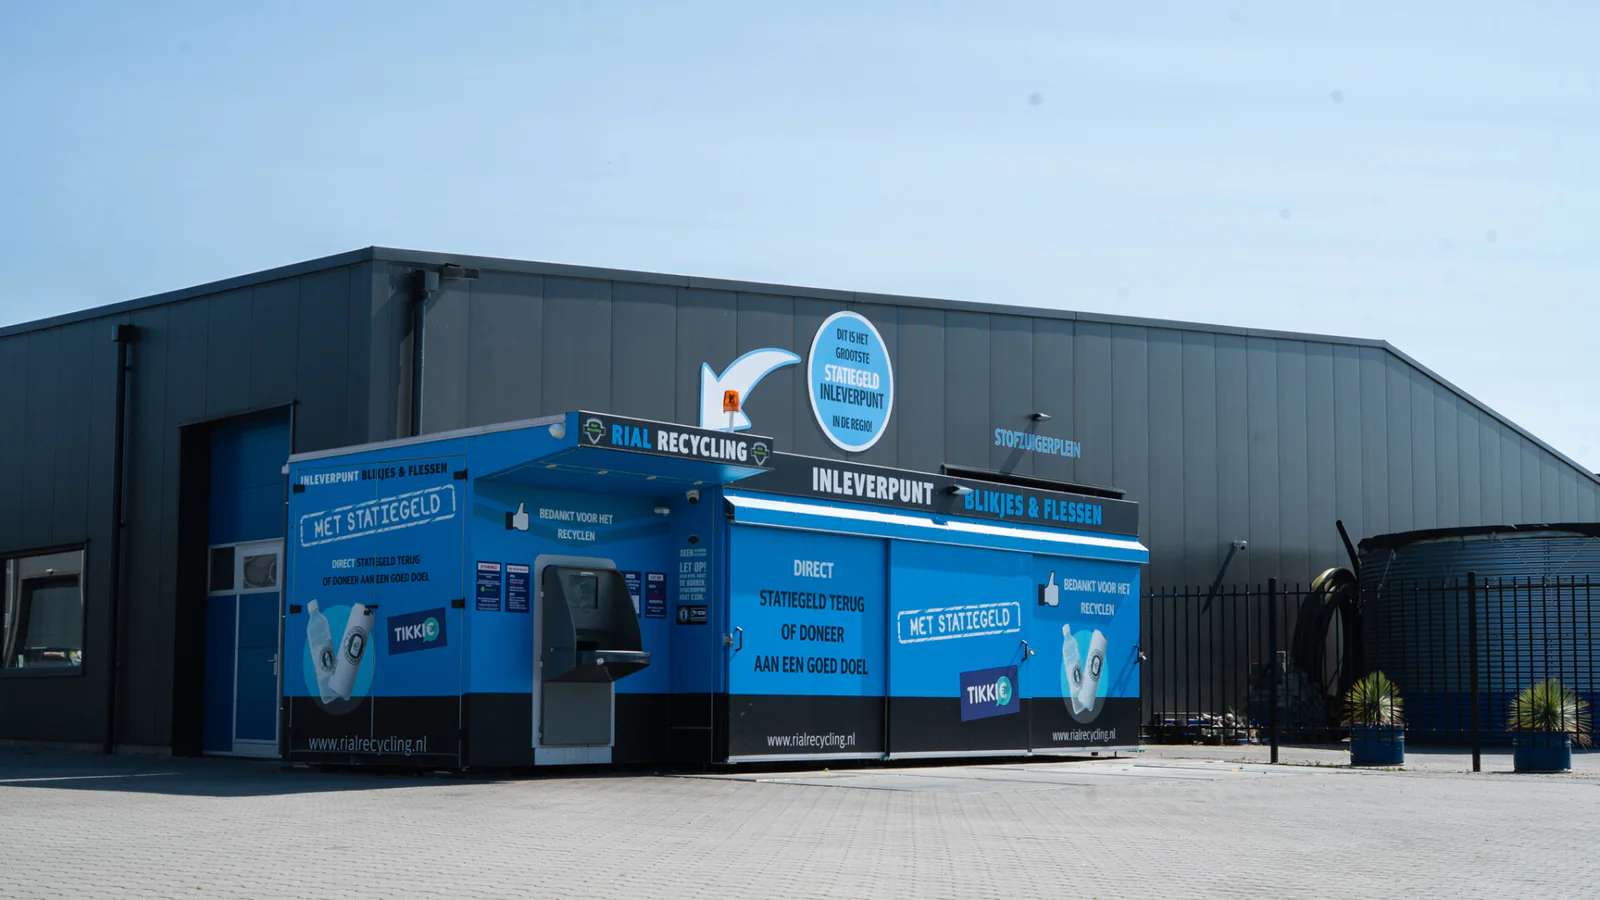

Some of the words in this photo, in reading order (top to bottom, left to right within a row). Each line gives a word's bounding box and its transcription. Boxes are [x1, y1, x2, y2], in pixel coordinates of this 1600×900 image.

[837, 328, 848, 341] DIT
[849, 331, 856, 342] IS
[857, 332, 869, 345] HET
[836, 347, 870, 364] GROOTSTE
[825, 364, 879, 390] STATIEGELD
[820, 383, 884, 410] INLEVERPUNT
[833, 415, 840, 428] IN
[841, 417, 850, 429] DE
[851, 419, 873, 432] REGIO!
[612, 424, 652, 449] RIAL
[658, 430, 747, 462] RECYCLING
[995, 428, 1081, 458] STOFZUIGERPLEIN
[301, 471, 359, 486] INLEVERPUNT
[362, 467, 395, 481] BLIKJES
[398, 466, 406, 477] &
[409, 463, 448, 476] FLESSEN
[813, 467, 934, 505] INLEVERPUNT
[964, 489, 1025, 519] BLIKJES
[1028, 496, 1039, 519] &
[1044, 498, 1103, 526] FLESSEN
[315, 514, 341, 538] MET
[347, 493, 441, 531] STATIEGELD
[540, 508, 576, 523] BEDANKT
[576, 511, 598, 524] VOOR
[599, 514, 614, 525] HET
[558, 529, 596, 542] RECYCLEN
[332, 558, 356, 569] DIRECT
[356, 556, 396, 568] STATIEGELD
[397, 554, 420, 565] TERUG
[680, 561, 693, 573] LET
[694, 561, 706, 573] OP!
[794, 559, 835, 579] DIRECT
[323, 576, 331, 586] OF
[332, 575, 359, 586] DONEER
[360, 574, 375, 584] AAN
[376, 573, 389, 584] EEN
[390, 572, 411, 583] GOED
[412, 571, 430, 582] DOEL
[1063, 578, 1097, 593] BEDANKT
[1097, 580, 1117, 594] VOOR
[1117, 583, 1130, 596] HET
[760, 589, 827, 610] STATIEGELD
[829, 594, 865, 612] TERUG
[1080, 601, 1115, 617] RECYCLEN
[910, 616, 933, 636] MET
[938, 608, 1010, 633] STATIEGELD
[781, 623, 796, 640] OF
[800, 624, 845, 643] DONEER
[754, 655, 779, 673] AAN
[782, 656, 804, 673] EEN
[807, 657, 837, 674] GOED
[841, 658, 869, 675] DOEL
[309, 734, 428, 756] www.rialrecycling.nl
[767, 732, 856, 749] www.rialrecycling.nl
[1052, 728, 1117, 743] www.rialrecycling.nl
